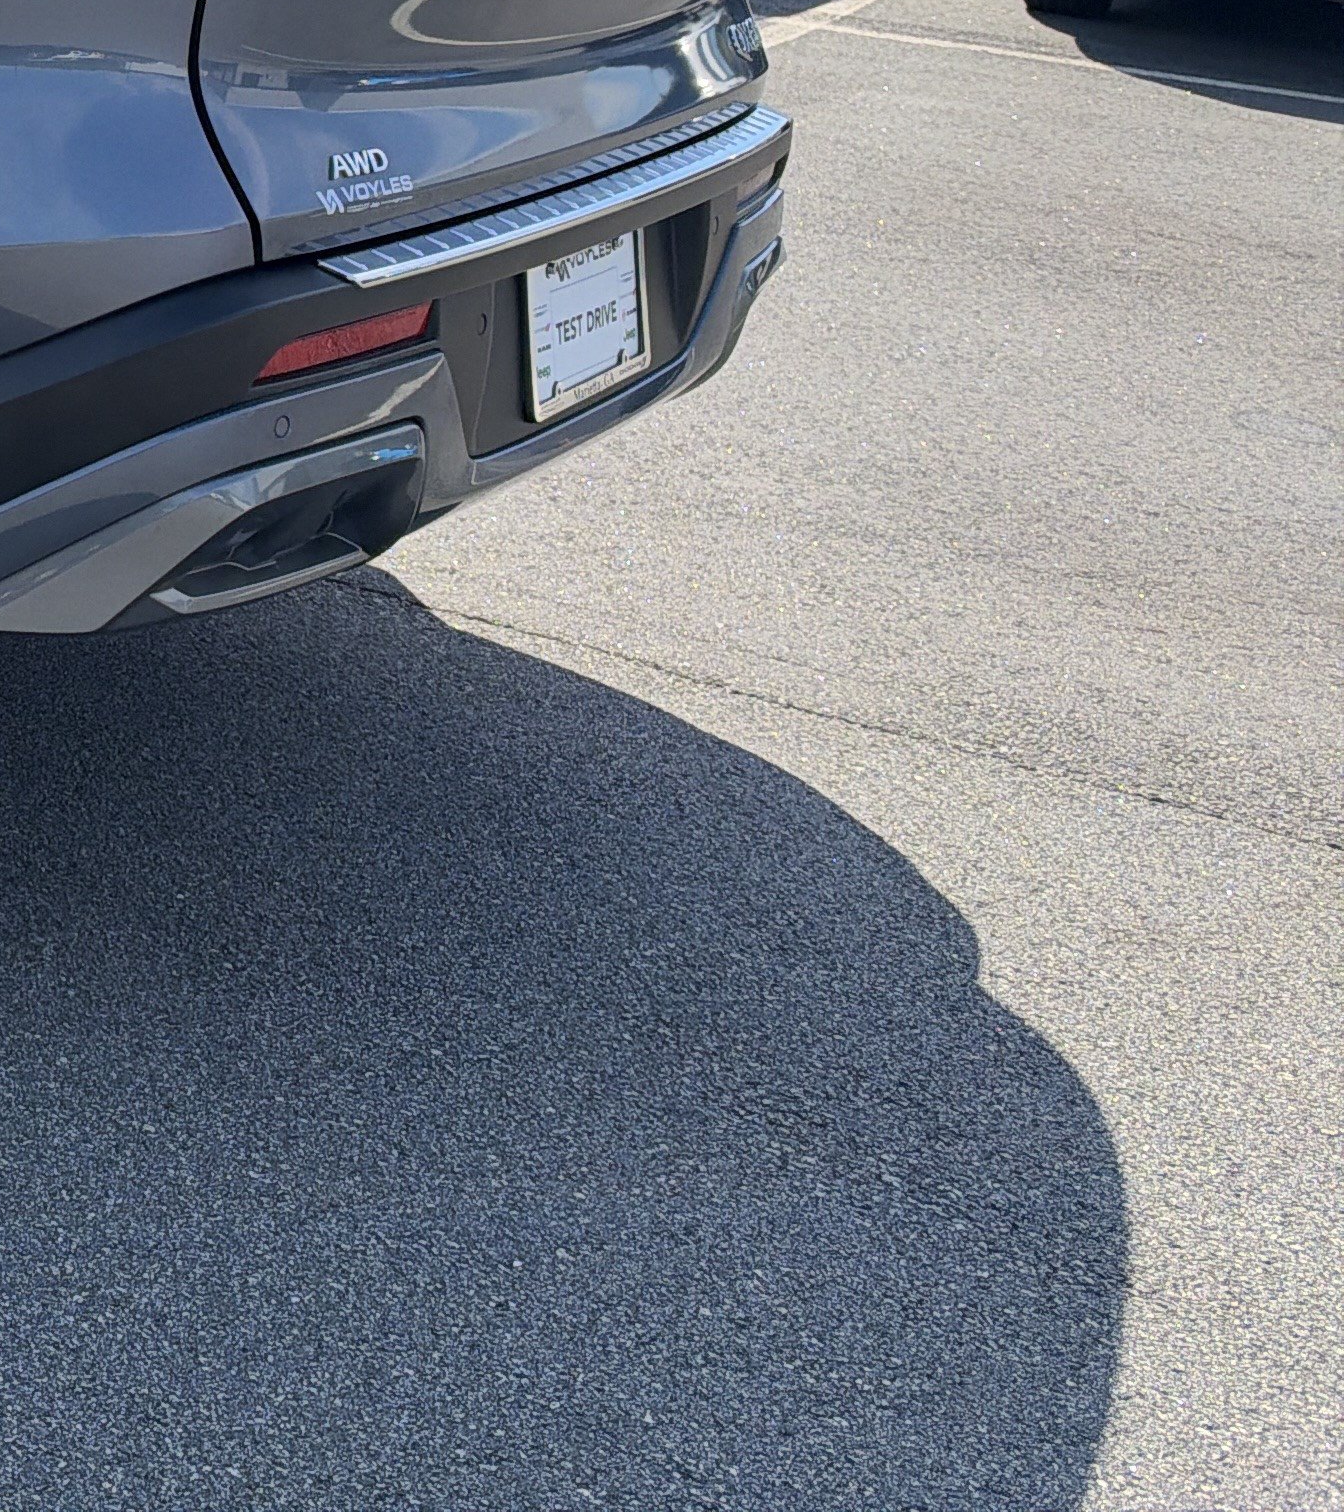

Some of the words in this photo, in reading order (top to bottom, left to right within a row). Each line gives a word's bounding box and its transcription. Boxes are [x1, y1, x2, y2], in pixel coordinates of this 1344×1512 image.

[329, 148, 389, 180] AWD
[340, 174, 414, 202] VOYLES
[566, 238, 613, 269] VOYLES
[555, 313, 583, 345] TEST
[586, 299, 618, 333] DRIVE
